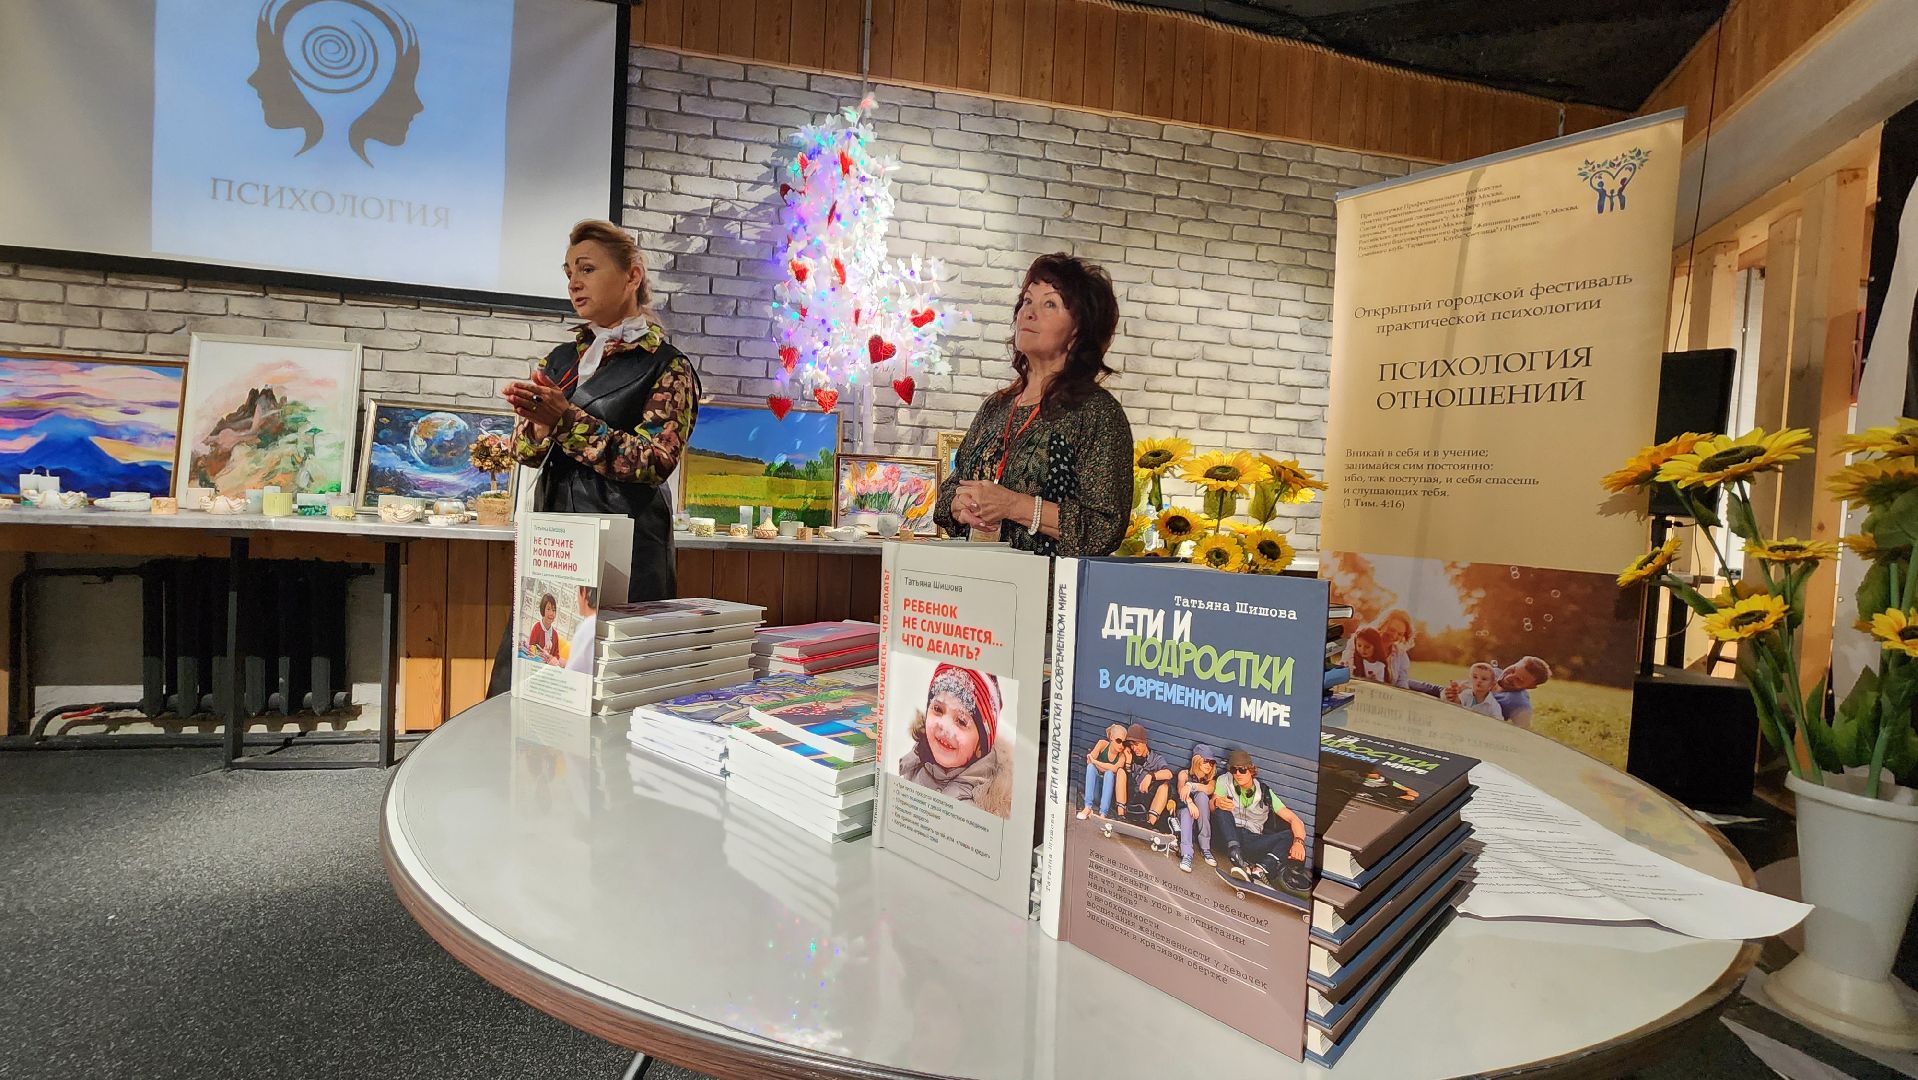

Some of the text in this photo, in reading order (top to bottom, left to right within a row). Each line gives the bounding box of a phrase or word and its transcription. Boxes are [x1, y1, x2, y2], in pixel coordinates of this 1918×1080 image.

[210, 177, 451, 229] ПСИХОЛОГИЯ
[1354, 272, 1633, 320] Открытый городской фестиваль
[1376, 298, 1602, 336] практической психологии
[1378, 346, 1594, 382] ПСИХОЛОГИЯ
[1376, 376, 1588, 411] ОТНОШЕНИЙ
[1344, 461, 1494, 471] занимайся сим постоянно:
[1345, 447, 1385, 458] Вникай
[1395, 447, 1420, 458] себя
[1423, 449, 1430, 457] и
[1433, 449, 1440, 457] в
[1442, 448, 1489, 460] учение;
[1344, 473, 1366, 484] ибо,
[1367, 475, 1386, 483] так
[1388, 475, 1443, 488] поступая,
[1445, 476, 1453, 484] и
[1456, 474, 1482, 485] себя
[1352, 487, 1418, 498] слушающих
[1421, 487, 1450, 498] тебя.
[1354, 498, 1379, 508] Тим.
[1380, 499, 1405, 511] 4:16)
[533, 536, 574, 549] НЕ СТУЧИТЕ
[533, 547, 571, 560] МОЛОТКОМ
[532, 558, 578, 572] ПО ПИАНИНО
[883, 568, 891, 612] ДЕЛАТЬ?
[904, 576, 963, 593] Татьяна Шишова
[903, 598, 958, 619] РЕБЕНОК
[1102, 603, 1193, 645] ДЕТИ И
[1174, 595, 1297, 621] Татьяна Шишова
[901, 633, 981, 662] ЧТО ДЕЛАТЬ?
[902, 615, 1003, 647] НЕ СЛУШАЕТСЯ...
[1126, 635, 1295, 695] ПОДРОСТКИ
[1050, 583, 1067, 804] ДЕТИ И ПОДРОСТКИ В СОВРЕМЕННОМ МИРЕ
[1099, 668, 1291, 727] В СОВРЕМЕННОМ МИРЕ
[879, 704, 885, 718] НЕ
[876, 720, 884, 763] РЕБЕНОК
[1088, 859, 1150, 892] Дети и деньги
[1089, 848, 1104, 861] Как
[1107, 857, 1117, 866] не
[1119, 864, 1160, 884] потерять
[1162, 879, 1202, 901] контакт
[1213, 901, 1269, 928] ребенком?
[1086, 890, 1160, 930] О необходимости
[1087, 880, 1138, 908] мальчиков?
[1088, 870, 1099, 881] На
[1100, 877, 1115, 888] что
[1117, 885, 1148, 903] делать
[1151, 899, 1173, 915] упор
[1184, 915, 1246, 946] воспитании
[1086, 900, 1268, 989] воспитания женственности у девочек
[1140, 937, 1184, 962] красивой
[1187, 960, 1228, 985] обертке
